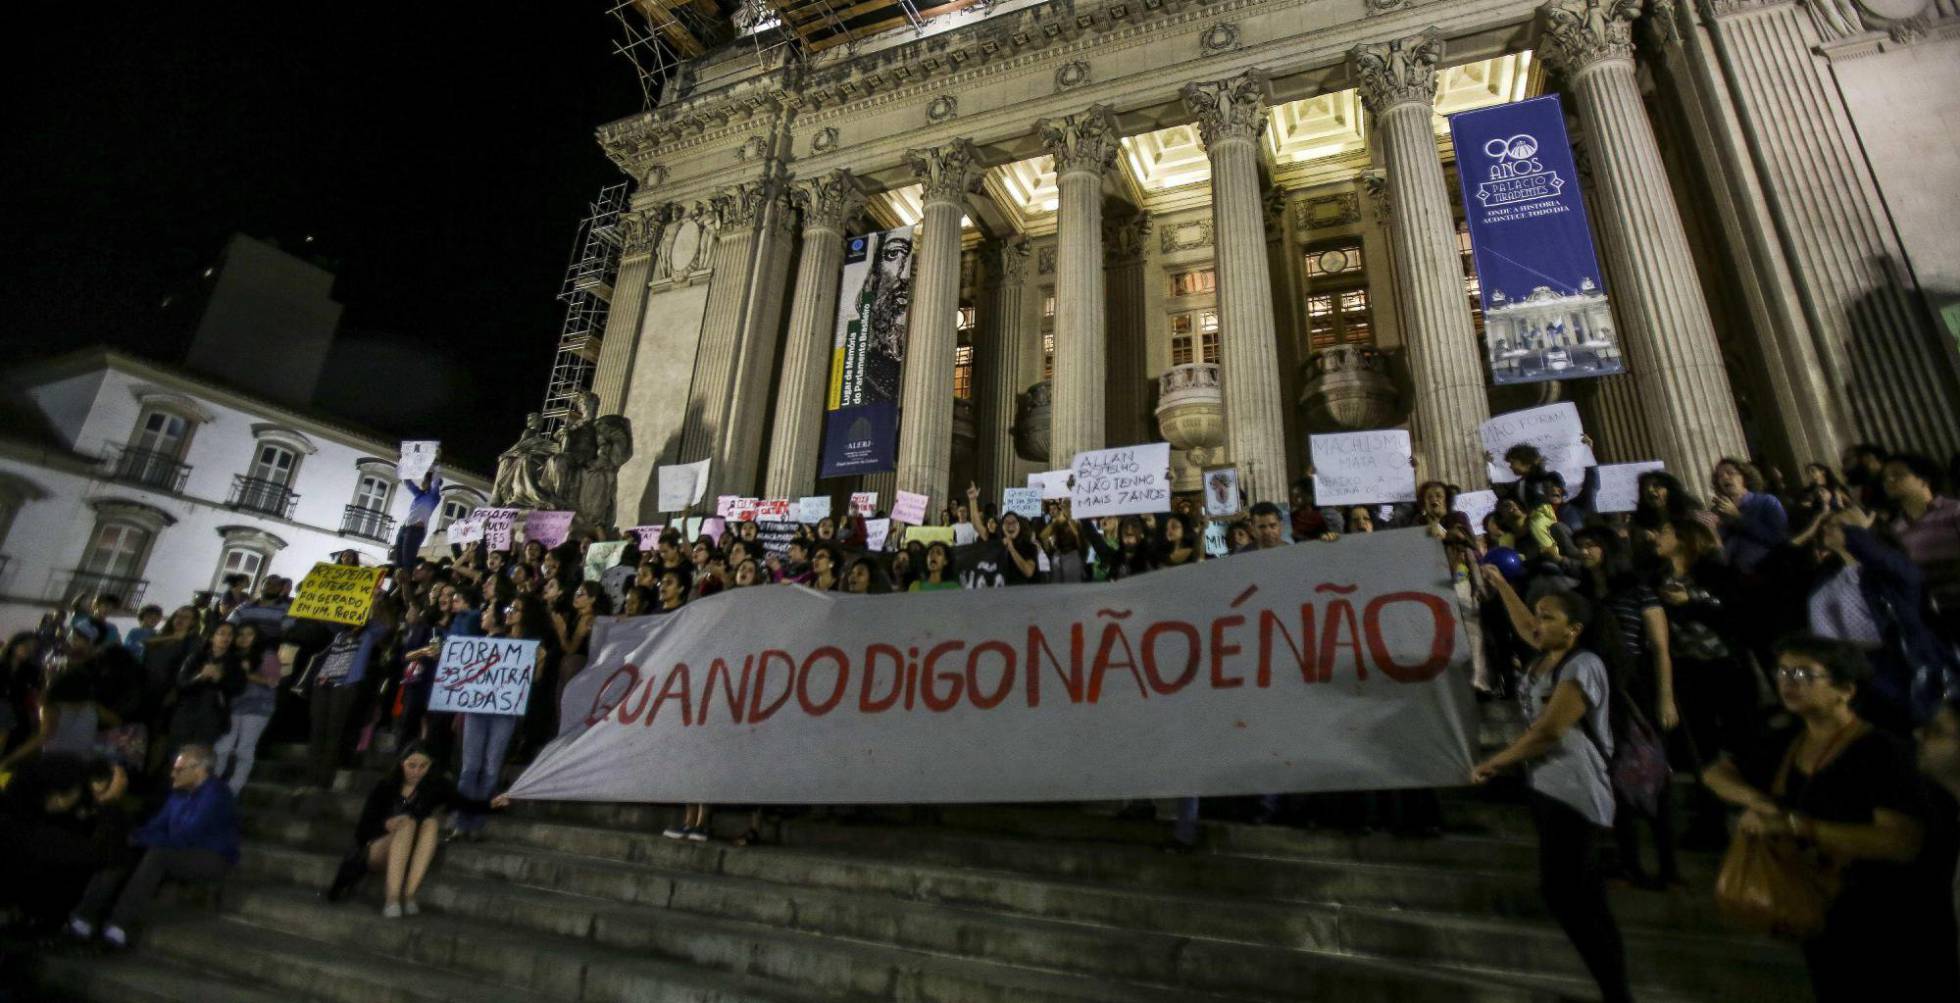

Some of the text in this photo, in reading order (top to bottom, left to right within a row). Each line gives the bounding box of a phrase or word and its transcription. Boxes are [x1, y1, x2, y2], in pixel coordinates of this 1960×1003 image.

[1485, 134, 1538, 163] 90
[1490, 157, 1543, 180] ANOS
[1493, 185, 1549, 202] TIRADENTES
[1483, 205, 1570, 224] ACONTECE TODO DIA
[1488, 207, 1511, 216] ONDE
[845, 332, 857, 368] Memória
[853, 303, 871, 405] do Parlamento Brasileiro
[841, 382, 853, 406] Lugar
[1080, 450, 1135, 468] ALLAN
[1076, 473, 1155, 494] NÃO TENHO
[1078, 495, 1113, 508] MAIS
[1129, 488, 1167, 503] ANOS
[296, 603, 311, 614] EM
[299, 591, 364, 608] FOI GERADO
[446, 640, 523, 665] FORAM
[584, 645, 850, 727] QUANDO
[1026, 608, 1201, 708] NÃO
[1211, 584, 1258, 689] É
[1257, 582, 1456, 688] NÃO
[465, 664, 532, 688] CONTRA
[443, 683, 526, 712] TODAS!
